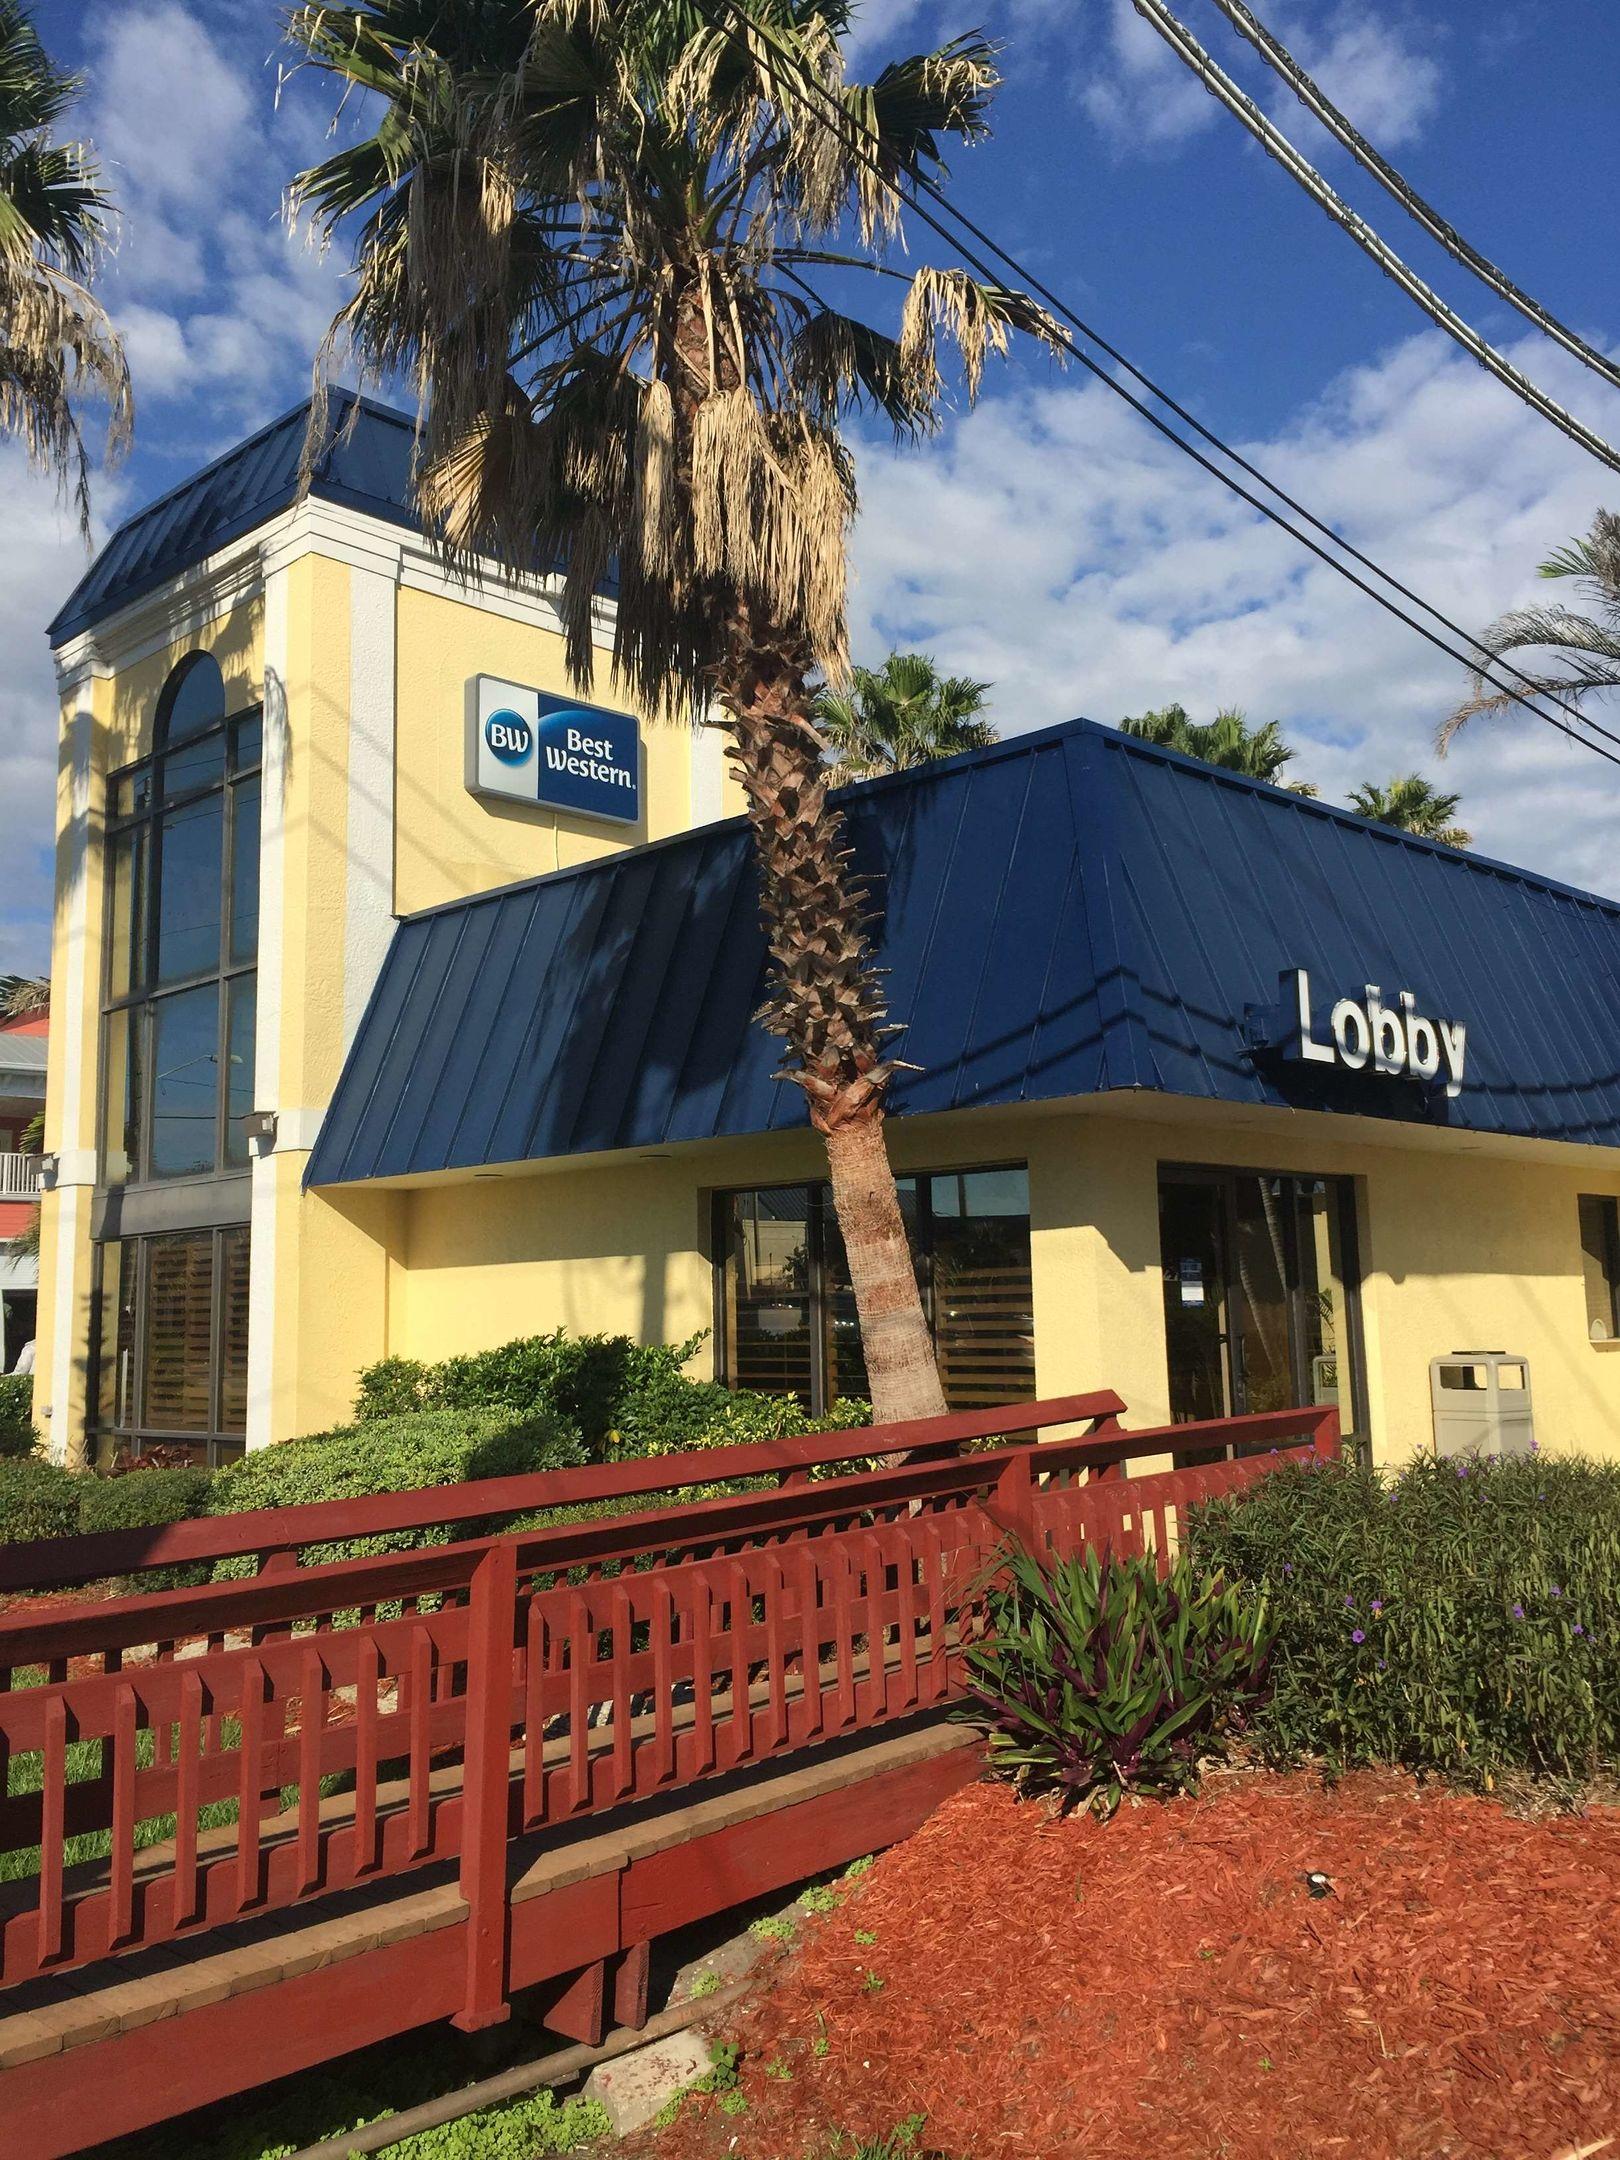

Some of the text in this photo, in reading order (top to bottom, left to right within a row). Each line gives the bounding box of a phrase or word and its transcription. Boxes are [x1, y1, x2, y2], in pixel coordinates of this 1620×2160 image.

[491, 723, 529, 753] BW
[567, 728, 614, 761] Best
[1297, 968, 1466, 1098] Lobby
